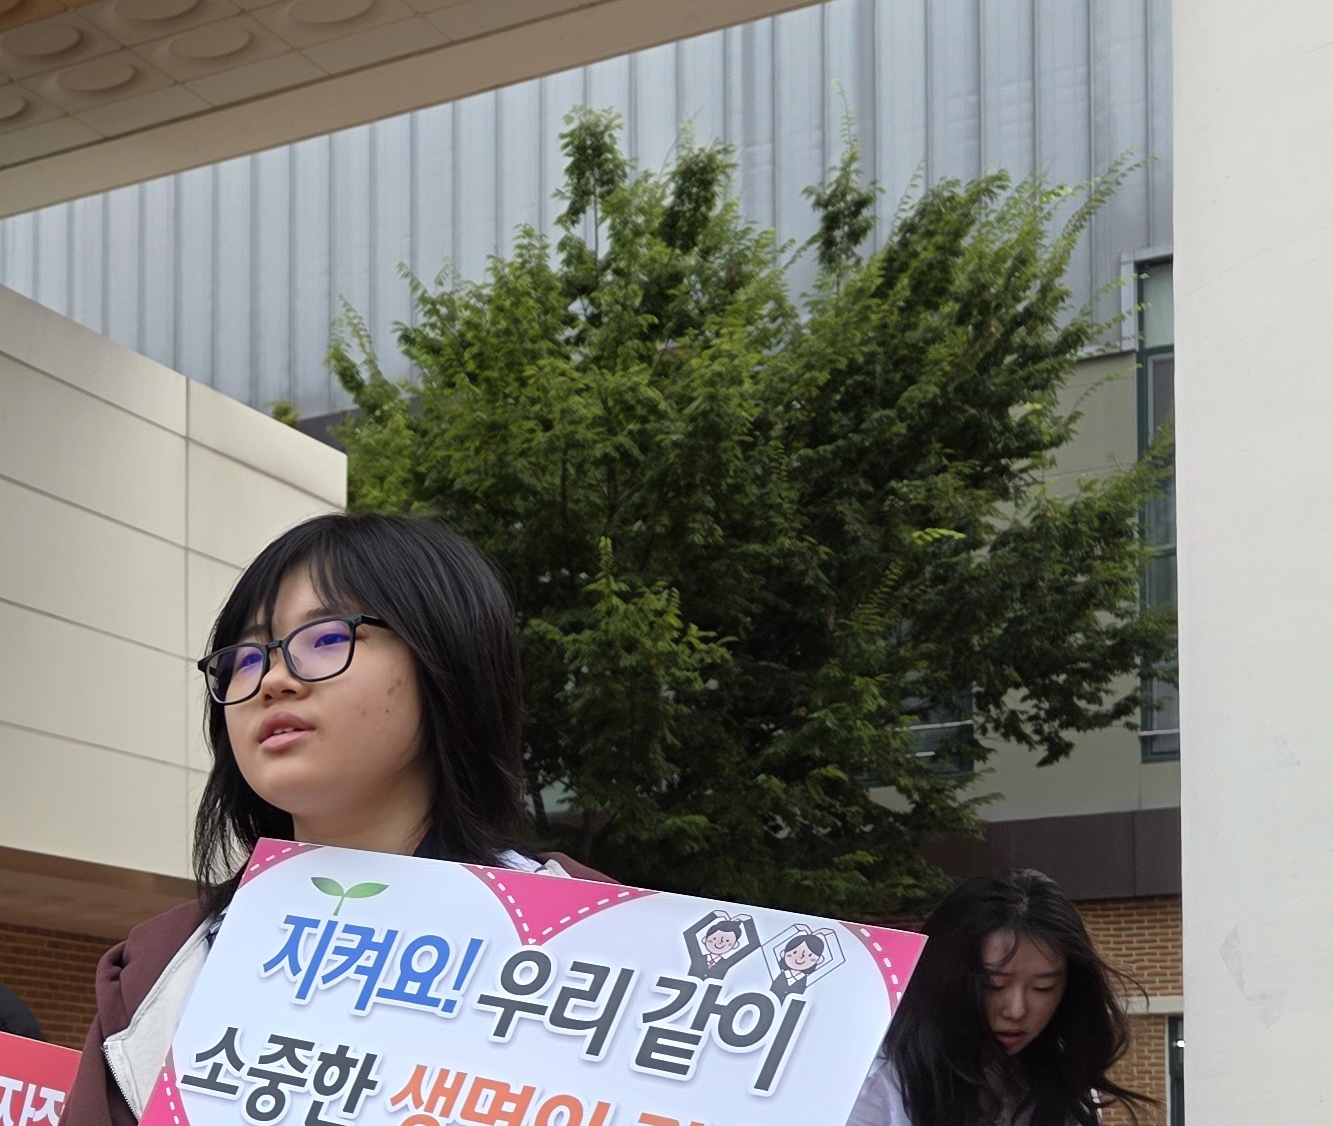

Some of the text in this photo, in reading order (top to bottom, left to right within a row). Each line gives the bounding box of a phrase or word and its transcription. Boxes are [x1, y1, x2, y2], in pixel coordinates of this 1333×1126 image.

[263, 913, 807, 1092] 지켜요! 우리 같이
